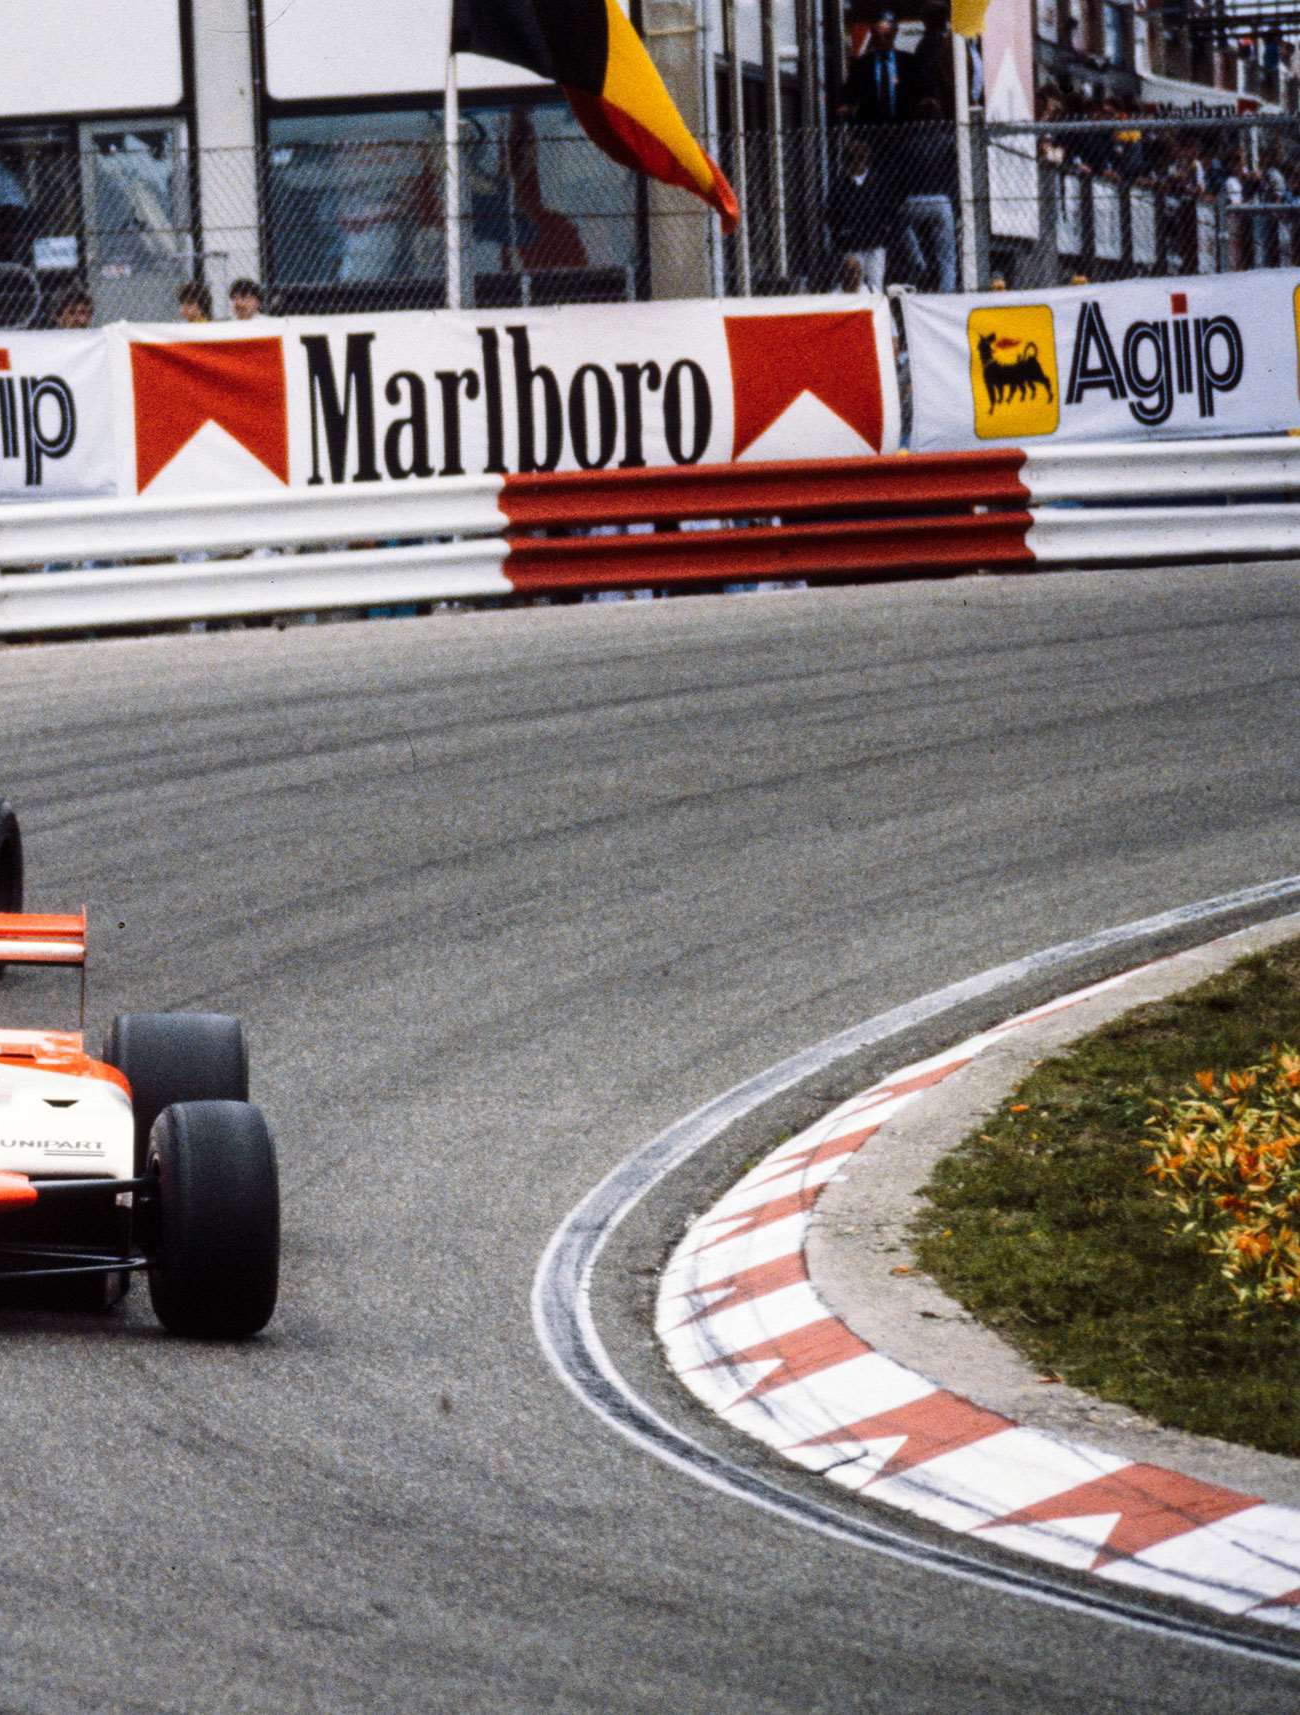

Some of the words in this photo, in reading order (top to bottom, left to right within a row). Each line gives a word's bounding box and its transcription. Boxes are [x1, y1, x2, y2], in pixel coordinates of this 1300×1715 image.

[301, 325, 712, 486] Marlboro
[1065, 293, 1244, 426] Agip
[0, 1139, 105, 1150] UNIPART
